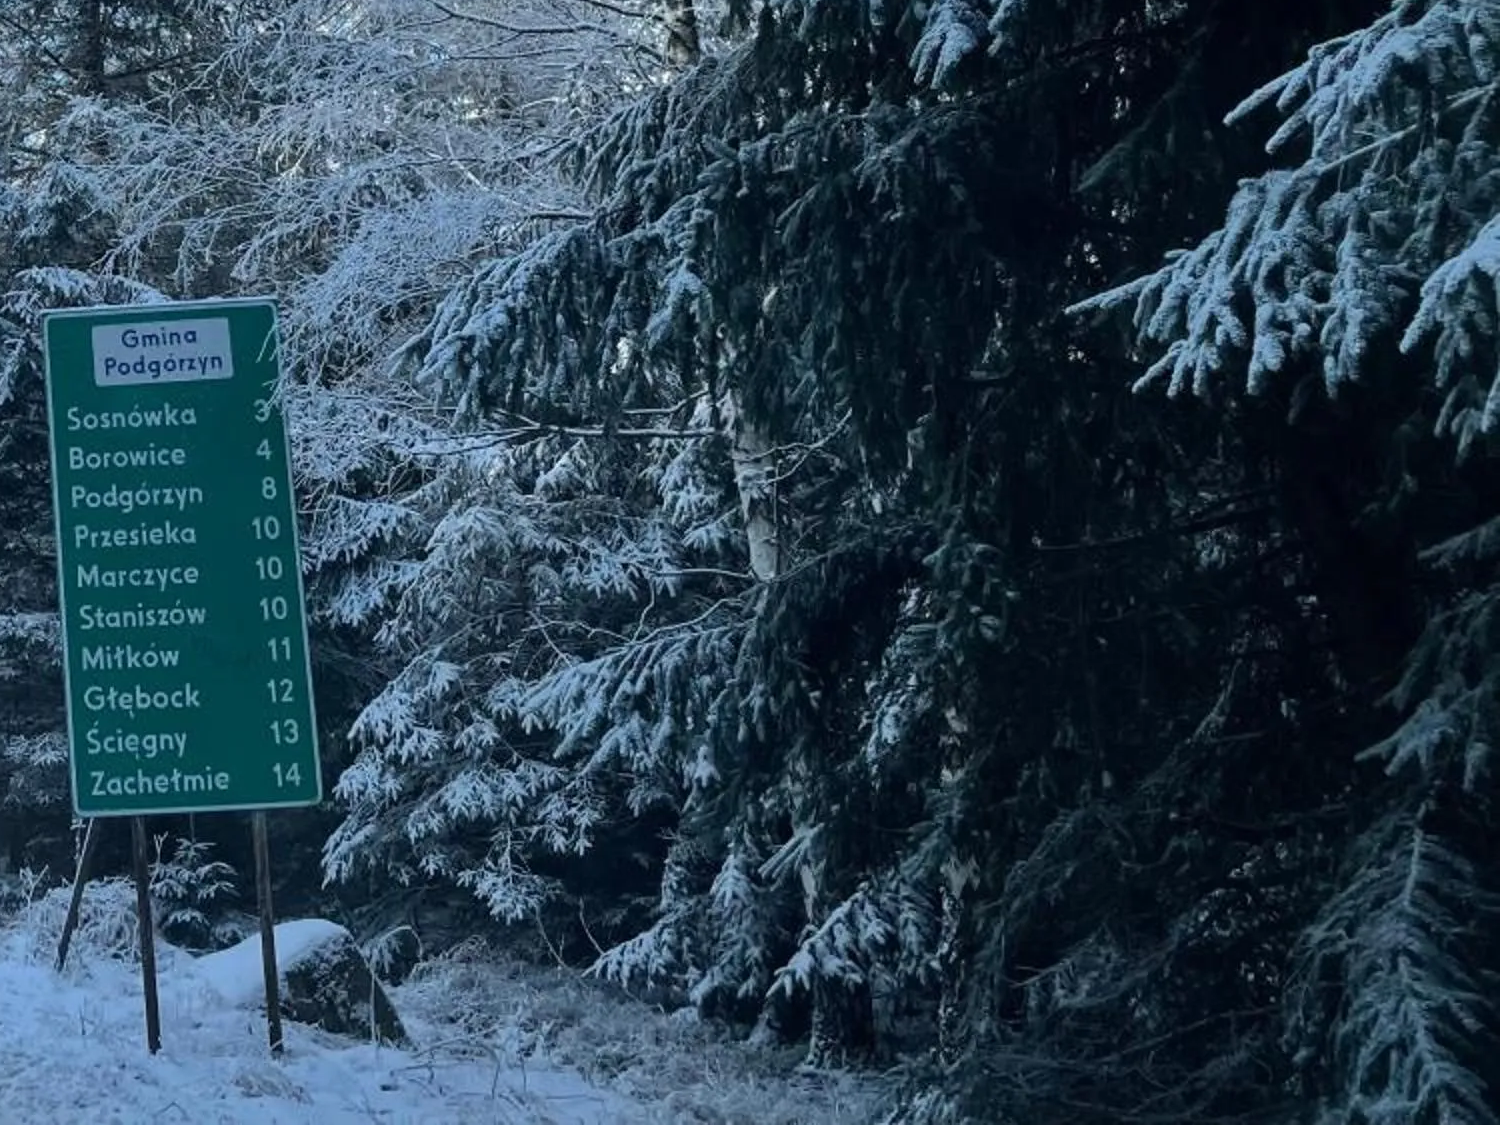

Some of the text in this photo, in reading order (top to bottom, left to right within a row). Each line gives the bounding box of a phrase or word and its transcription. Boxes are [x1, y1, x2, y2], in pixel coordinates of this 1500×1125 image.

[121, 329, 197, 348] Gmina
[104, 354, 223, 378] Podgórzyn
[67, 398, 271, 431] Sosnówka 3
[69, 439, 272, 470] Borowice 4
[71, 476, 277, 513] Podgórzyn 8
[74, 516, 280, 548] Przesieka 10
[77, 556, 283, 592] Marczyce 10
[79, 596, 288, 630] Staniszów 10
[81, 637, 291, 671] Miłków 11
[83, 678, 294, 719] Głębock 12
[86, 719, 299, 760] Ścięgny 13
[90, 762, 301, 796] Zachełmie 14
